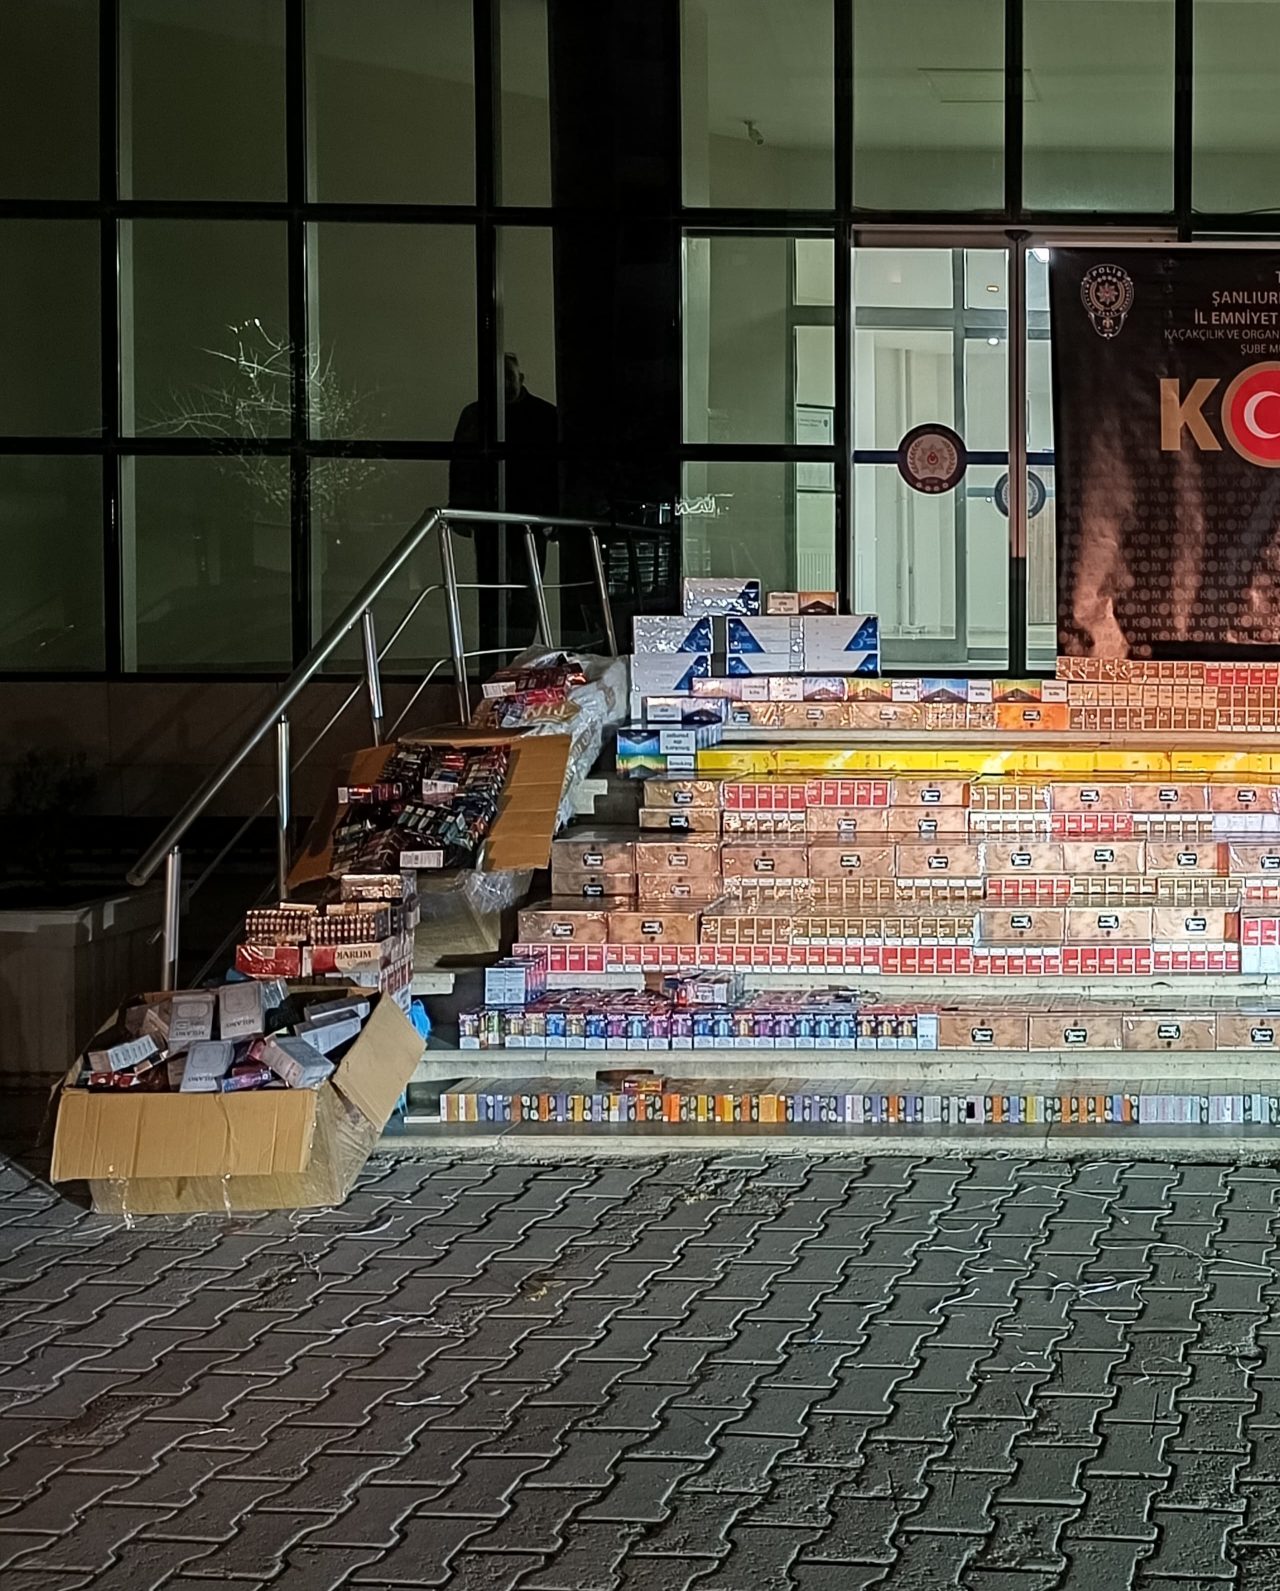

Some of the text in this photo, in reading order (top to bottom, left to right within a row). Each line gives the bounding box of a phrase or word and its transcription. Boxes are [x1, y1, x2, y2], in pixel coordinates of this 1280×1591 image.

[1194, 308, 1208, 325] İL
[1211, 309, 1278, 325] EMNİYET
[1164, 329, 1224, 341] KAÇAKÇILIK
[1226, 329, 1240, 339] VE
[1240, 343, 1267, 356] ŞUBE
